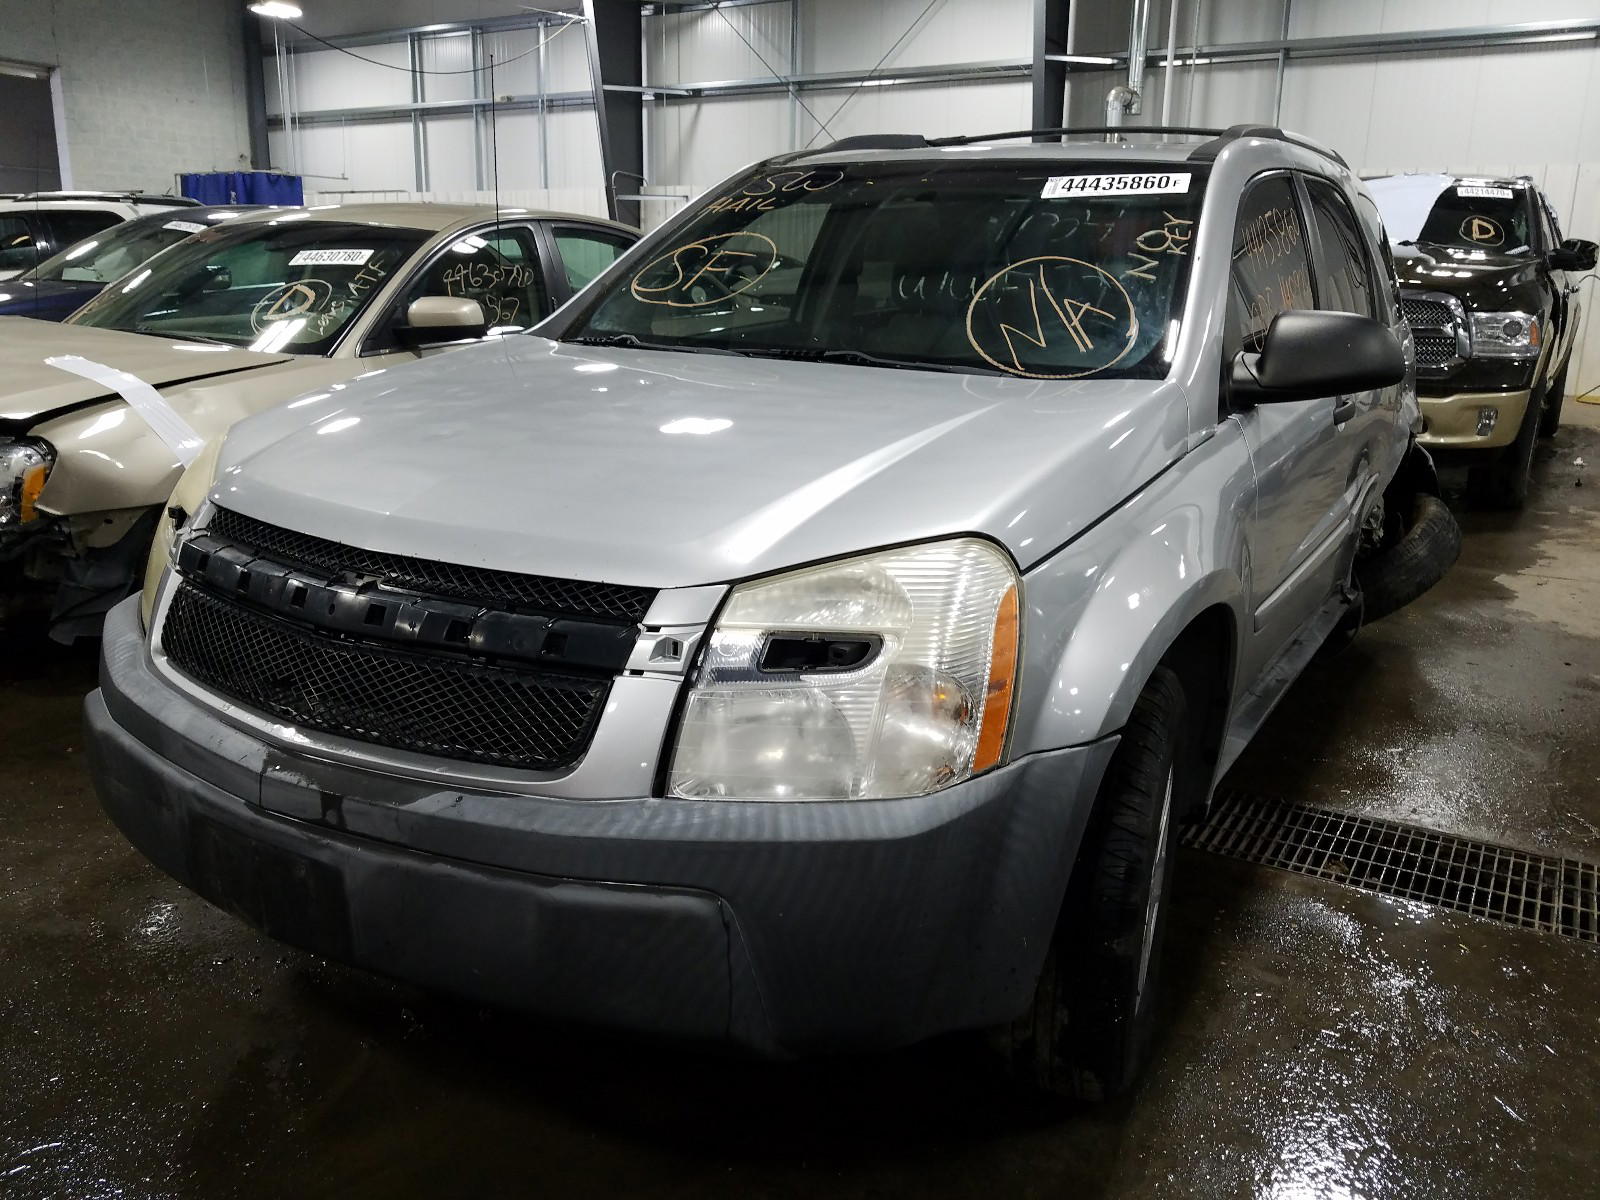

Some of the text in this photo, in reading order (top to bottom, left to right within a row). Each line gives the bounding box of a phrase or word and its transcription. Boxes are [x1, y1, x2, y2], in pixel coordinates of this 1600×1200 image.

[705, 196, 777, 214] HAIL
[1061, 175, 1171, 192] 44435860
[1173, 179, 1183, 187] F
[1165, 210, 1194, 255] KEY
[1472, 217, 1496, 241] D
[303, 251, 363, 262] 44630780
[347, 249, 388, 297] ATF
[633, 244, 757, 292] SF
[1125, 228, 1172, 281] NO
[999, 263, 1117, 371] N/A
